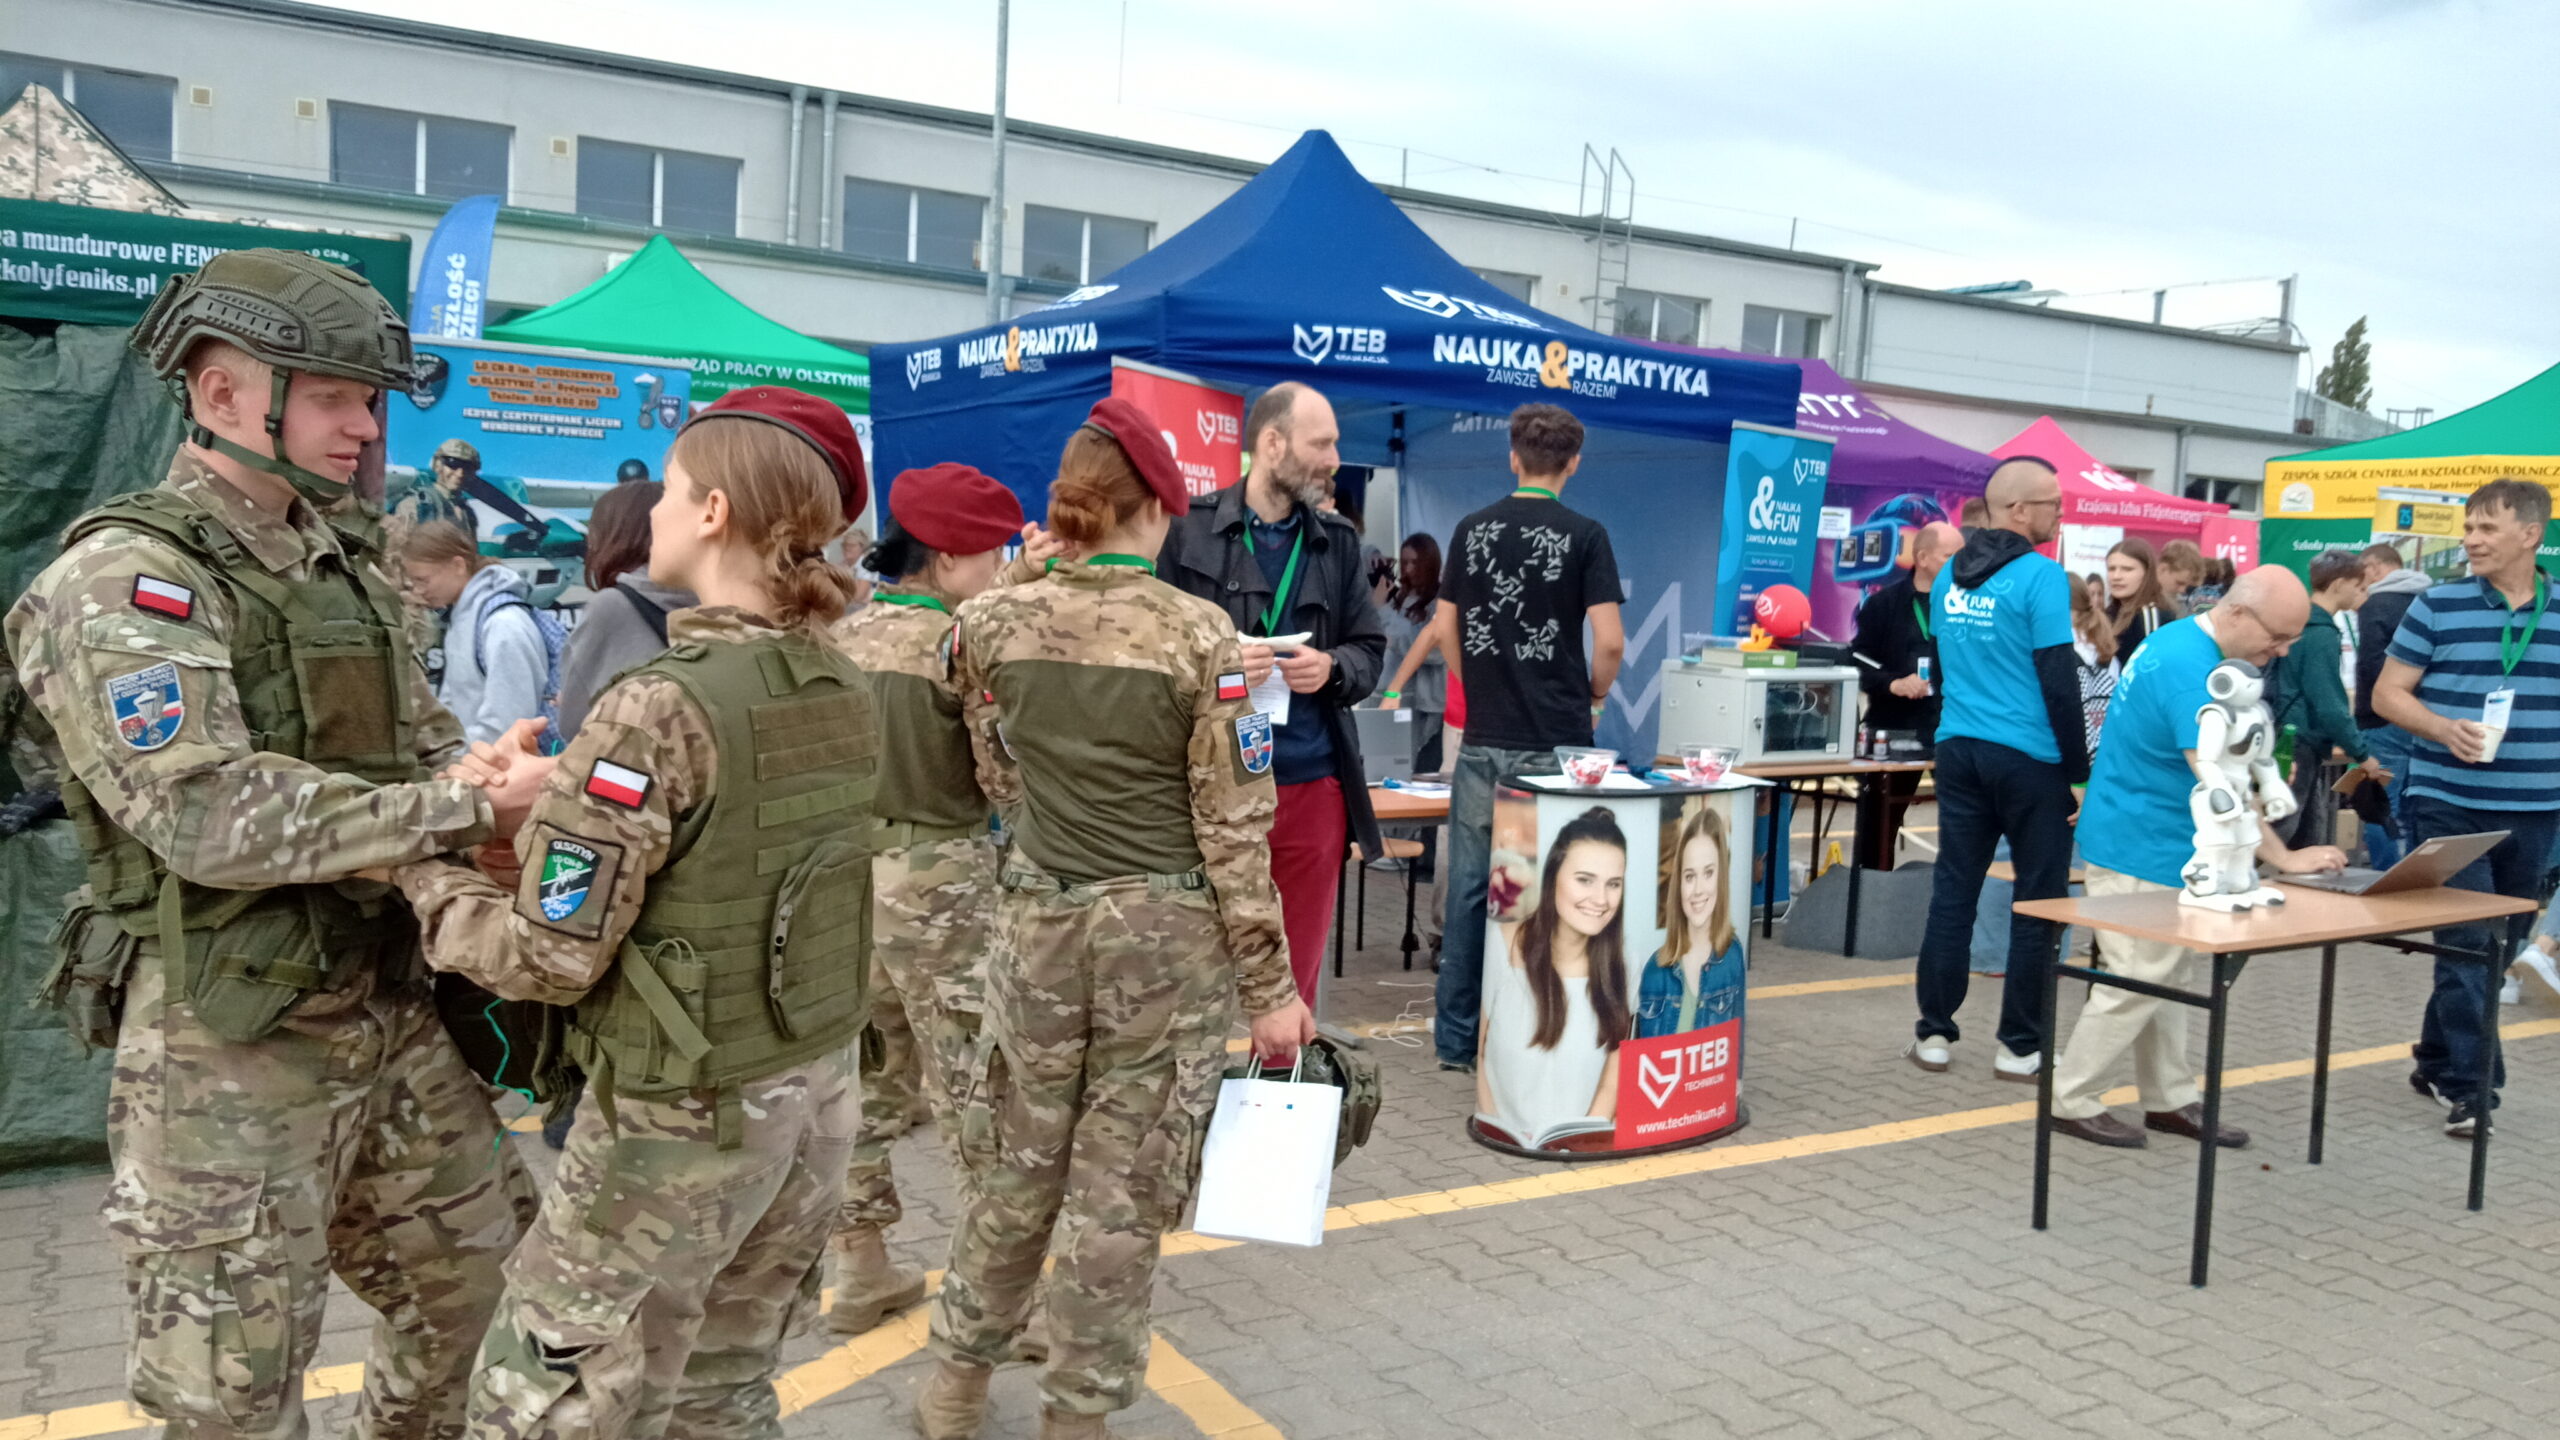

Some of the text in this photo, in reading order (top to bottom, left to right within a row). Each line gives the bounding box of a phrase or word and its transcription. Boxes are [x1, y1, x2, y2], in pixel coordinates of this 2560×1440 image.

[22, 232, 167, 263] mundurowe
[171, 242, 234, 267] FEN
[1335, 327, 1387, 353] TEB
[921, 347, 942, 371] TEB
[724, 361, 772, 378] PRACY
[774, 366, 793, 380] W
[795, 370, 872, 389] OLSZTYNIE
[1486, 368, 1617, 399] ZAWSZE RAZEM!
[1216, 413, 1239, 435] TEB
[1184, 463, 1216, 480] NAUKA
[1808, 459, 1827, 476] TEB
[2361, 467, 2419, 480] CENTRUM
[2421, 463, 2500, 477] KSZTAŁCENIA
[1774, 501, 1802, 514] NAUKA
[2076, 498, 2119, 516] Krajowa
[2120, 500, 2140, 517] Izba
[1772, 513, 1801, 533] FUN
[552, 840, 597, 862] OLSZTYN
[1685, 1036, 1729, 1075] TEB
[1684, 1073, 1725, 1092] TECHNIKUM
[1636, 1101, 1727, 1134] www.technikum.pl
